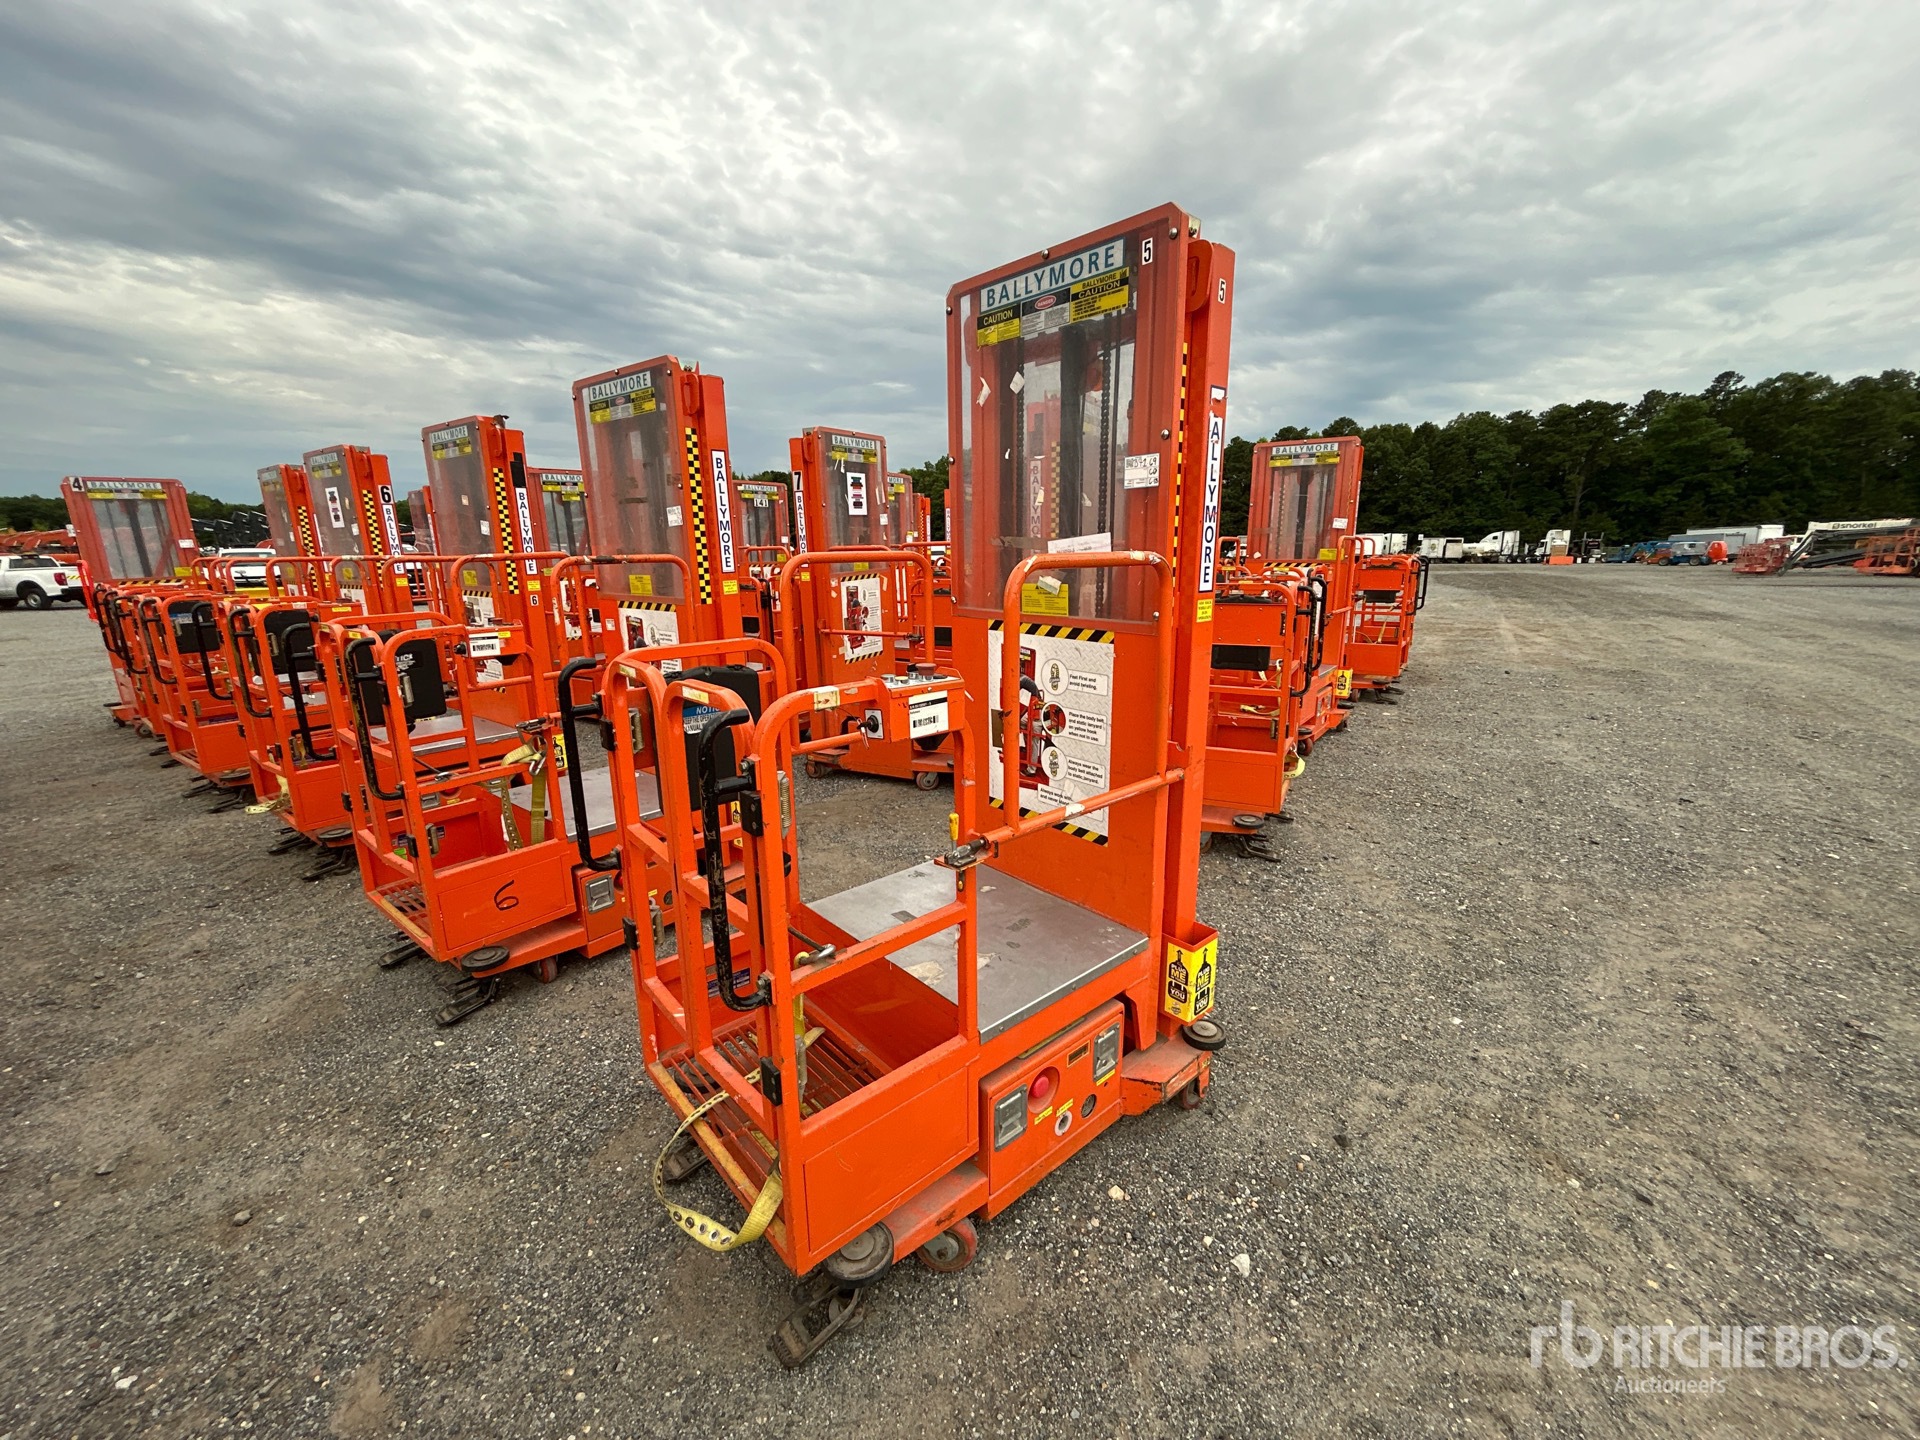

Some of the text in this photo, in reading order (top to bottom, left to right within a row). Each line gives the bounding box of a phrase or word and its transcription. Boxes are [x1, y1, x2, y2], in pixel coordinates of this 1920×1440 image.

[1143, 239, 1152, 263] 5
[987, 244, 1115, 308] BALLYMORE
[1082, 273, 1117, 289] BALLYMORE
[1079, 280, 1121, 299] CAUTION
[1219, 280, 1226, 302] 5
[983, 309, 1013, 326] CAUTION
[591, 373, 648, 400] BALLYMORE
[432, 426, 467, 443] BALLYMORE
[834, 435, 874, 449] BALLYMORE
[1275, 443, 1335, 454] BALLYMORE
[73, 477, 82, 491] 4
[794, 471, 801, 490] 7
[380, 485, 391, 503] 6
[1203, 421, 1220, 583] ALLYMORE
[715, 457, 731, 568] BALLYMORE
[518, 492, 535, 572] BALLYMOE
[797, 495, 807, 555] BALLYMOR
[385, 507, 403, 572] BALLYMOE
[531, 595, 538, 606] 6
[696, 705, 720, 715] NOTI
[493, 879, 519, 911] 6
[1171, 963, 1187, 974] PLUG
[1171, 968, 1186, 982] ME
[1198, 972, 1209, 986] ME
[1170, 988, 1185, 1000] YOU
[1196, 996, 1208, 1010] YOU
